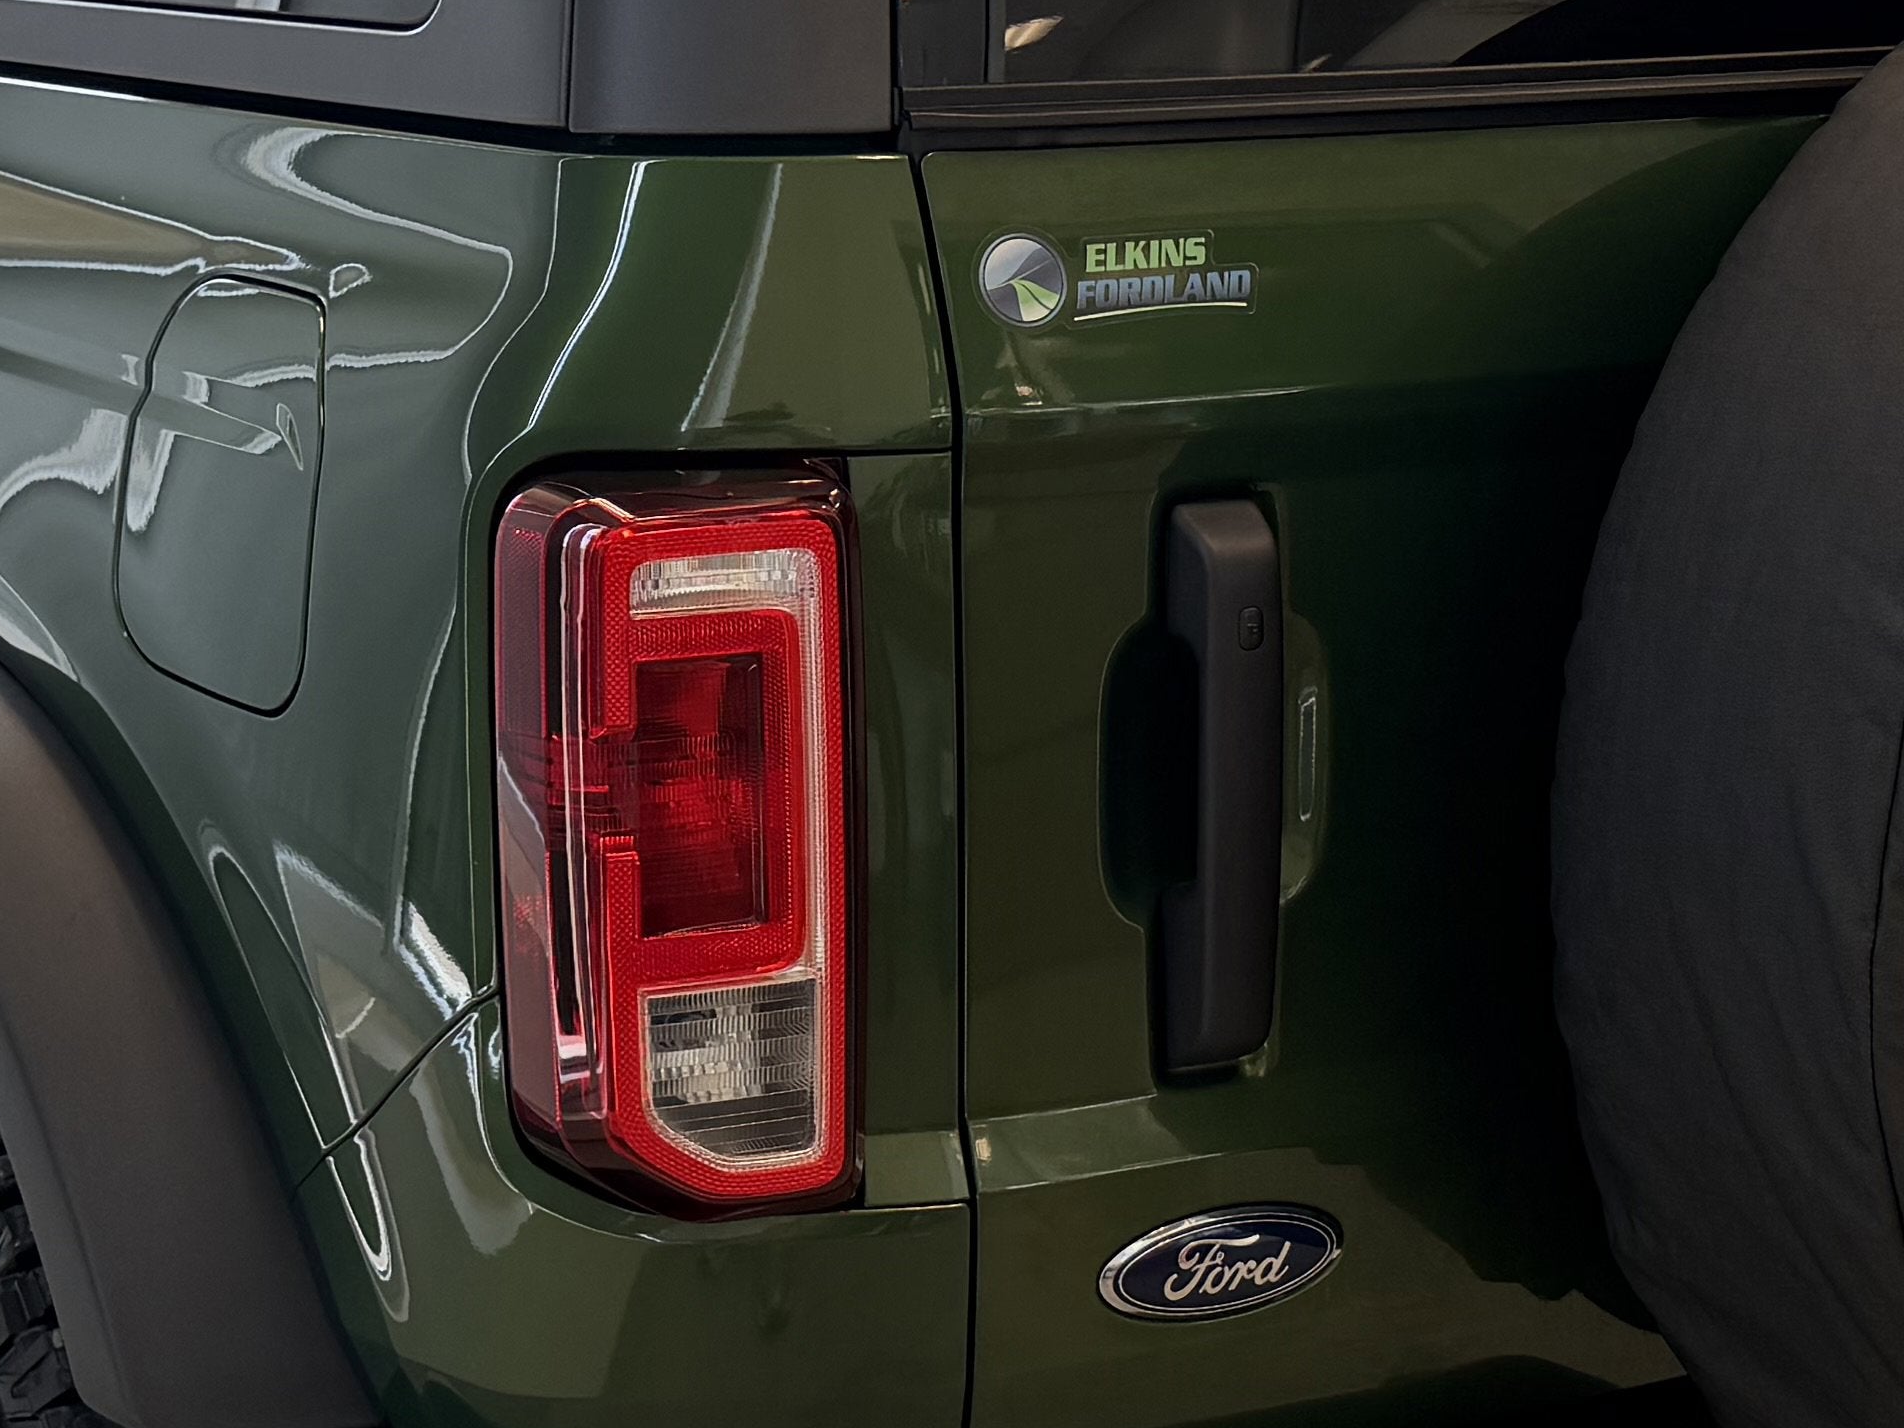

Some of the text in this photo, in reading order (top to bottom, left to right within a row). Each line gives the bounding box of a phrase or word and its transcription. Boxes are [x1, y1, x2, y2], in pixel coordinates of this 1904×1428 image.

[1085, 236, 1207, 273] ELKINS
[1076, 269, 1251, 310] FORDLAND
[1163, 1233, 1292, 1302] Ford
